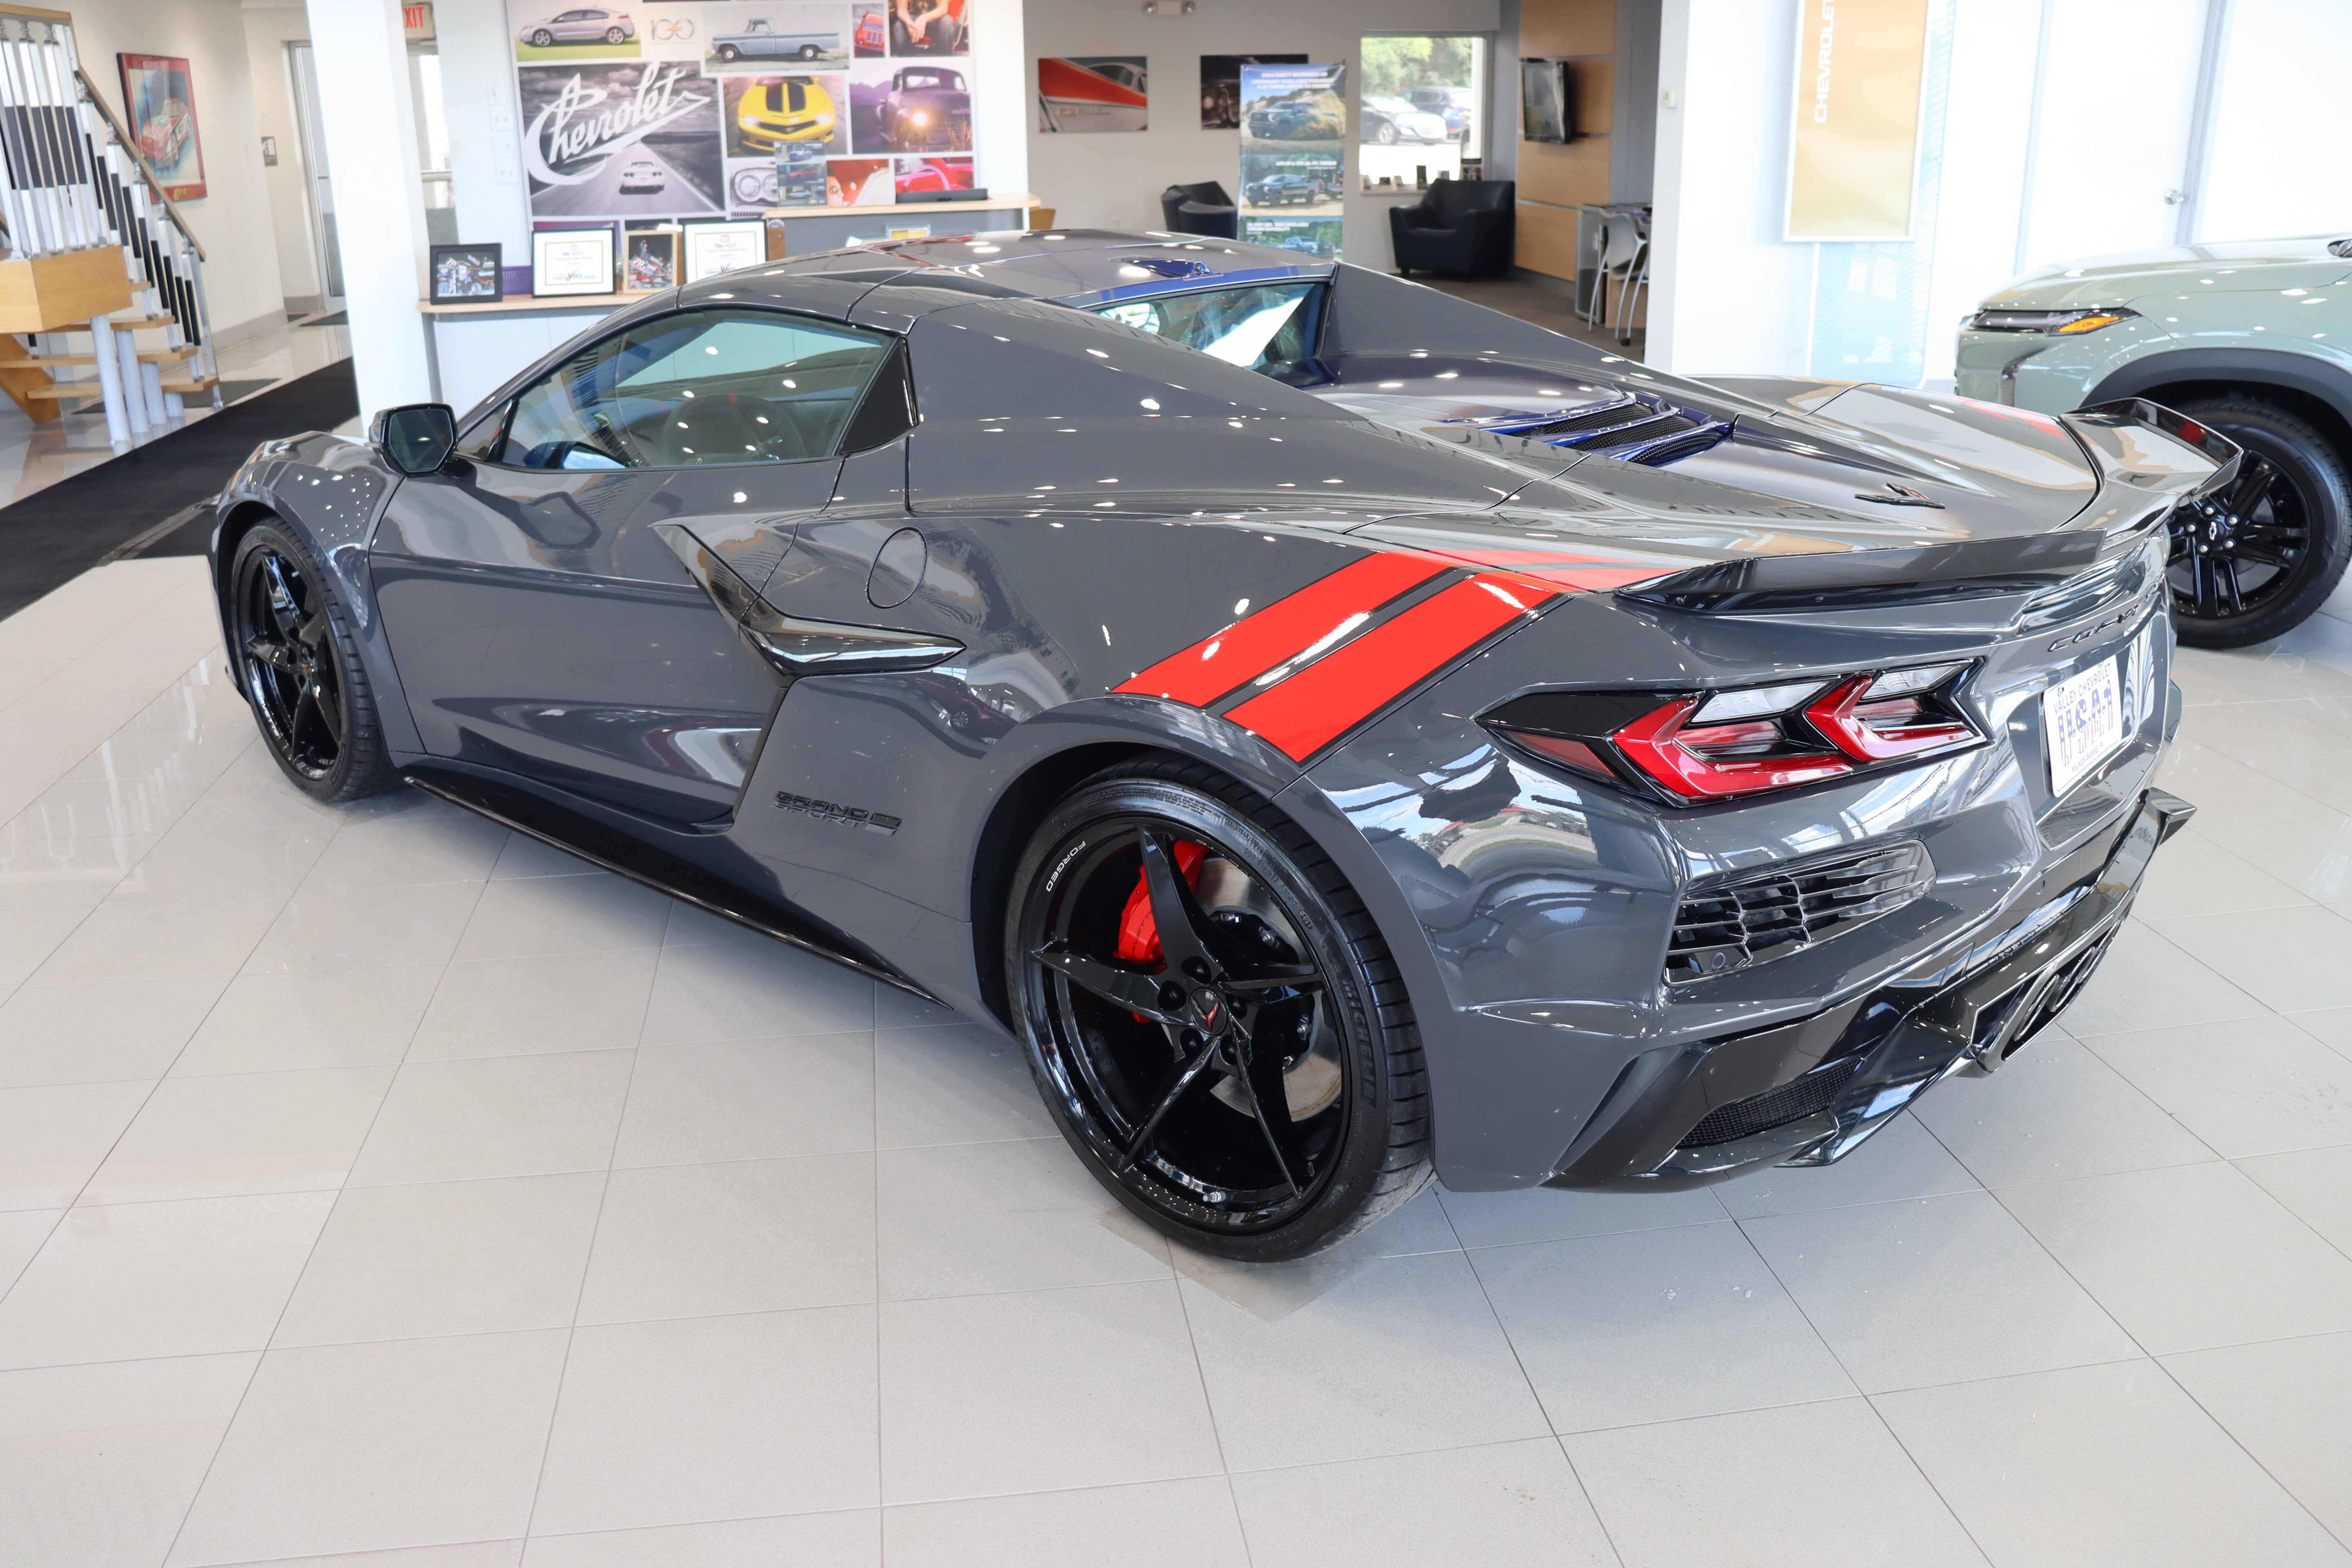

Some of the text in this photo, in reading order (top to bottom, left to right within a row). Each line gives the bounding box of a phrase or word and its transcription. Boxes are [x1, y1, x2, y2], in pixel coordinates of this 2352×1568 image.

[403, 6, 424, 28] XIT
[521, 60, 710, 185] Chevrolet
[2053, 663, 2111, 715] VALLEY CHEVROLET
[775, 800, 866, 827] SPORT
[776, 791, 869, 819] GRAND
[1046, 841, 1086, 892] FORGED
[1341, 978, 1376, 1102] MICHELIN
